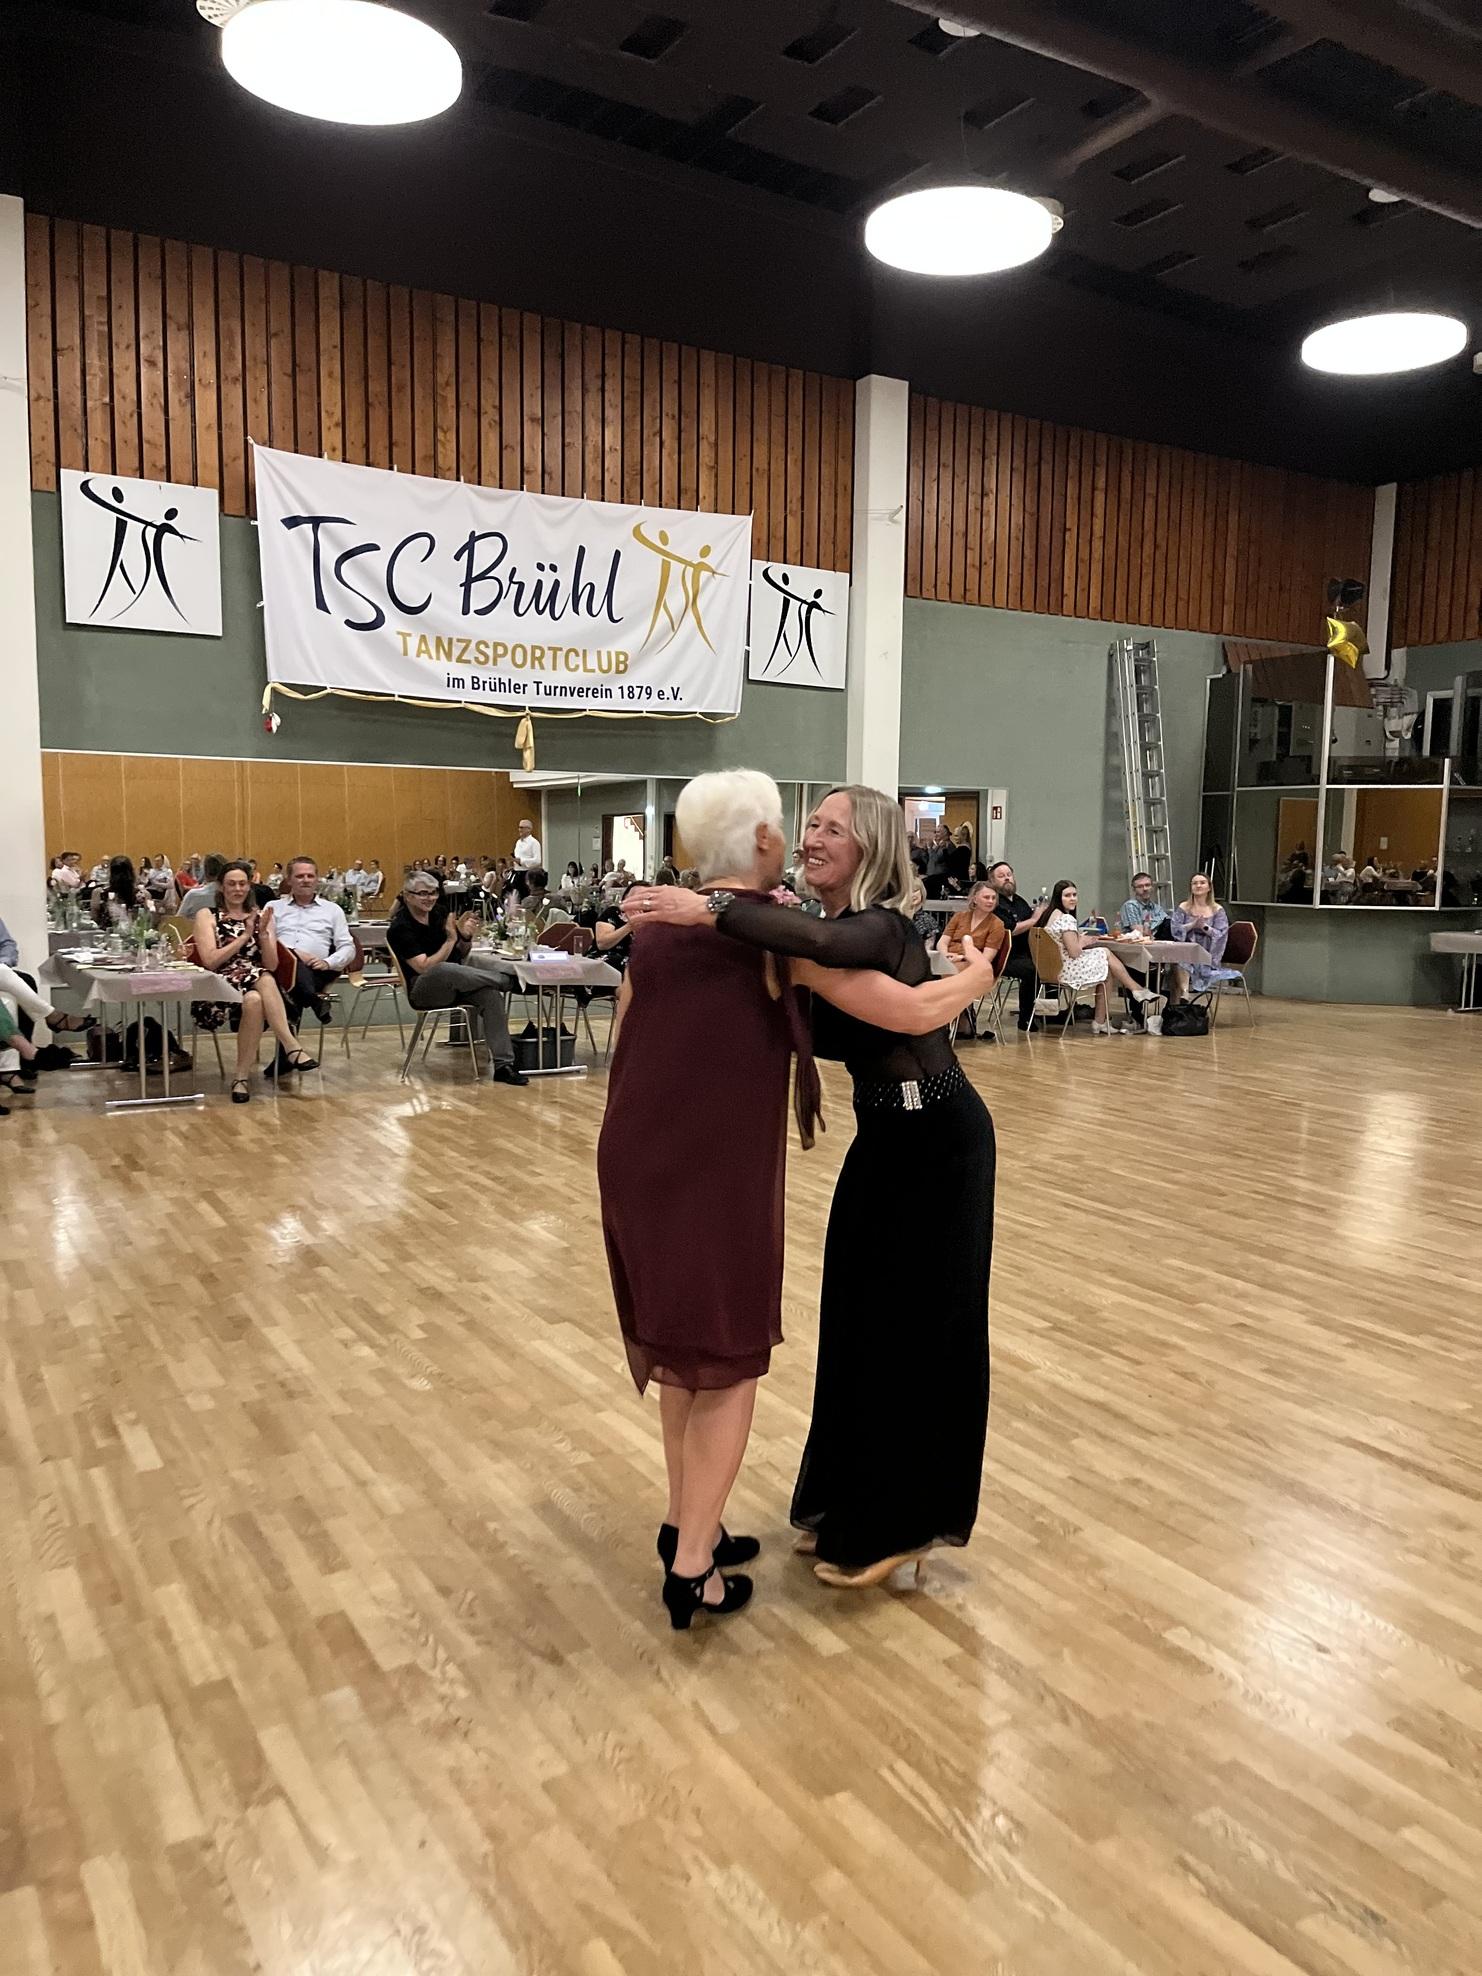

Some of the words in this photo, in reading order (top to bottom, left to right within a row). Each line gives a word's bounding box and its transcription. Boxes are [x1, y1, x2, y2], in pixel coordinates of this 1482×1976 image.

[280, 513, 436, 632] TSC
[453, 529, 624, 624] Brühl
[396, 630, 629, 675] TANZSPORTCLUB
[446, 672, 465, 690] im
[470, 675, 528, 695] Brühler
[532, 680, 613, 699] Turnverein
[617, 685, 653, 701] 1879
[657, 686, 683, 701] e.V.
